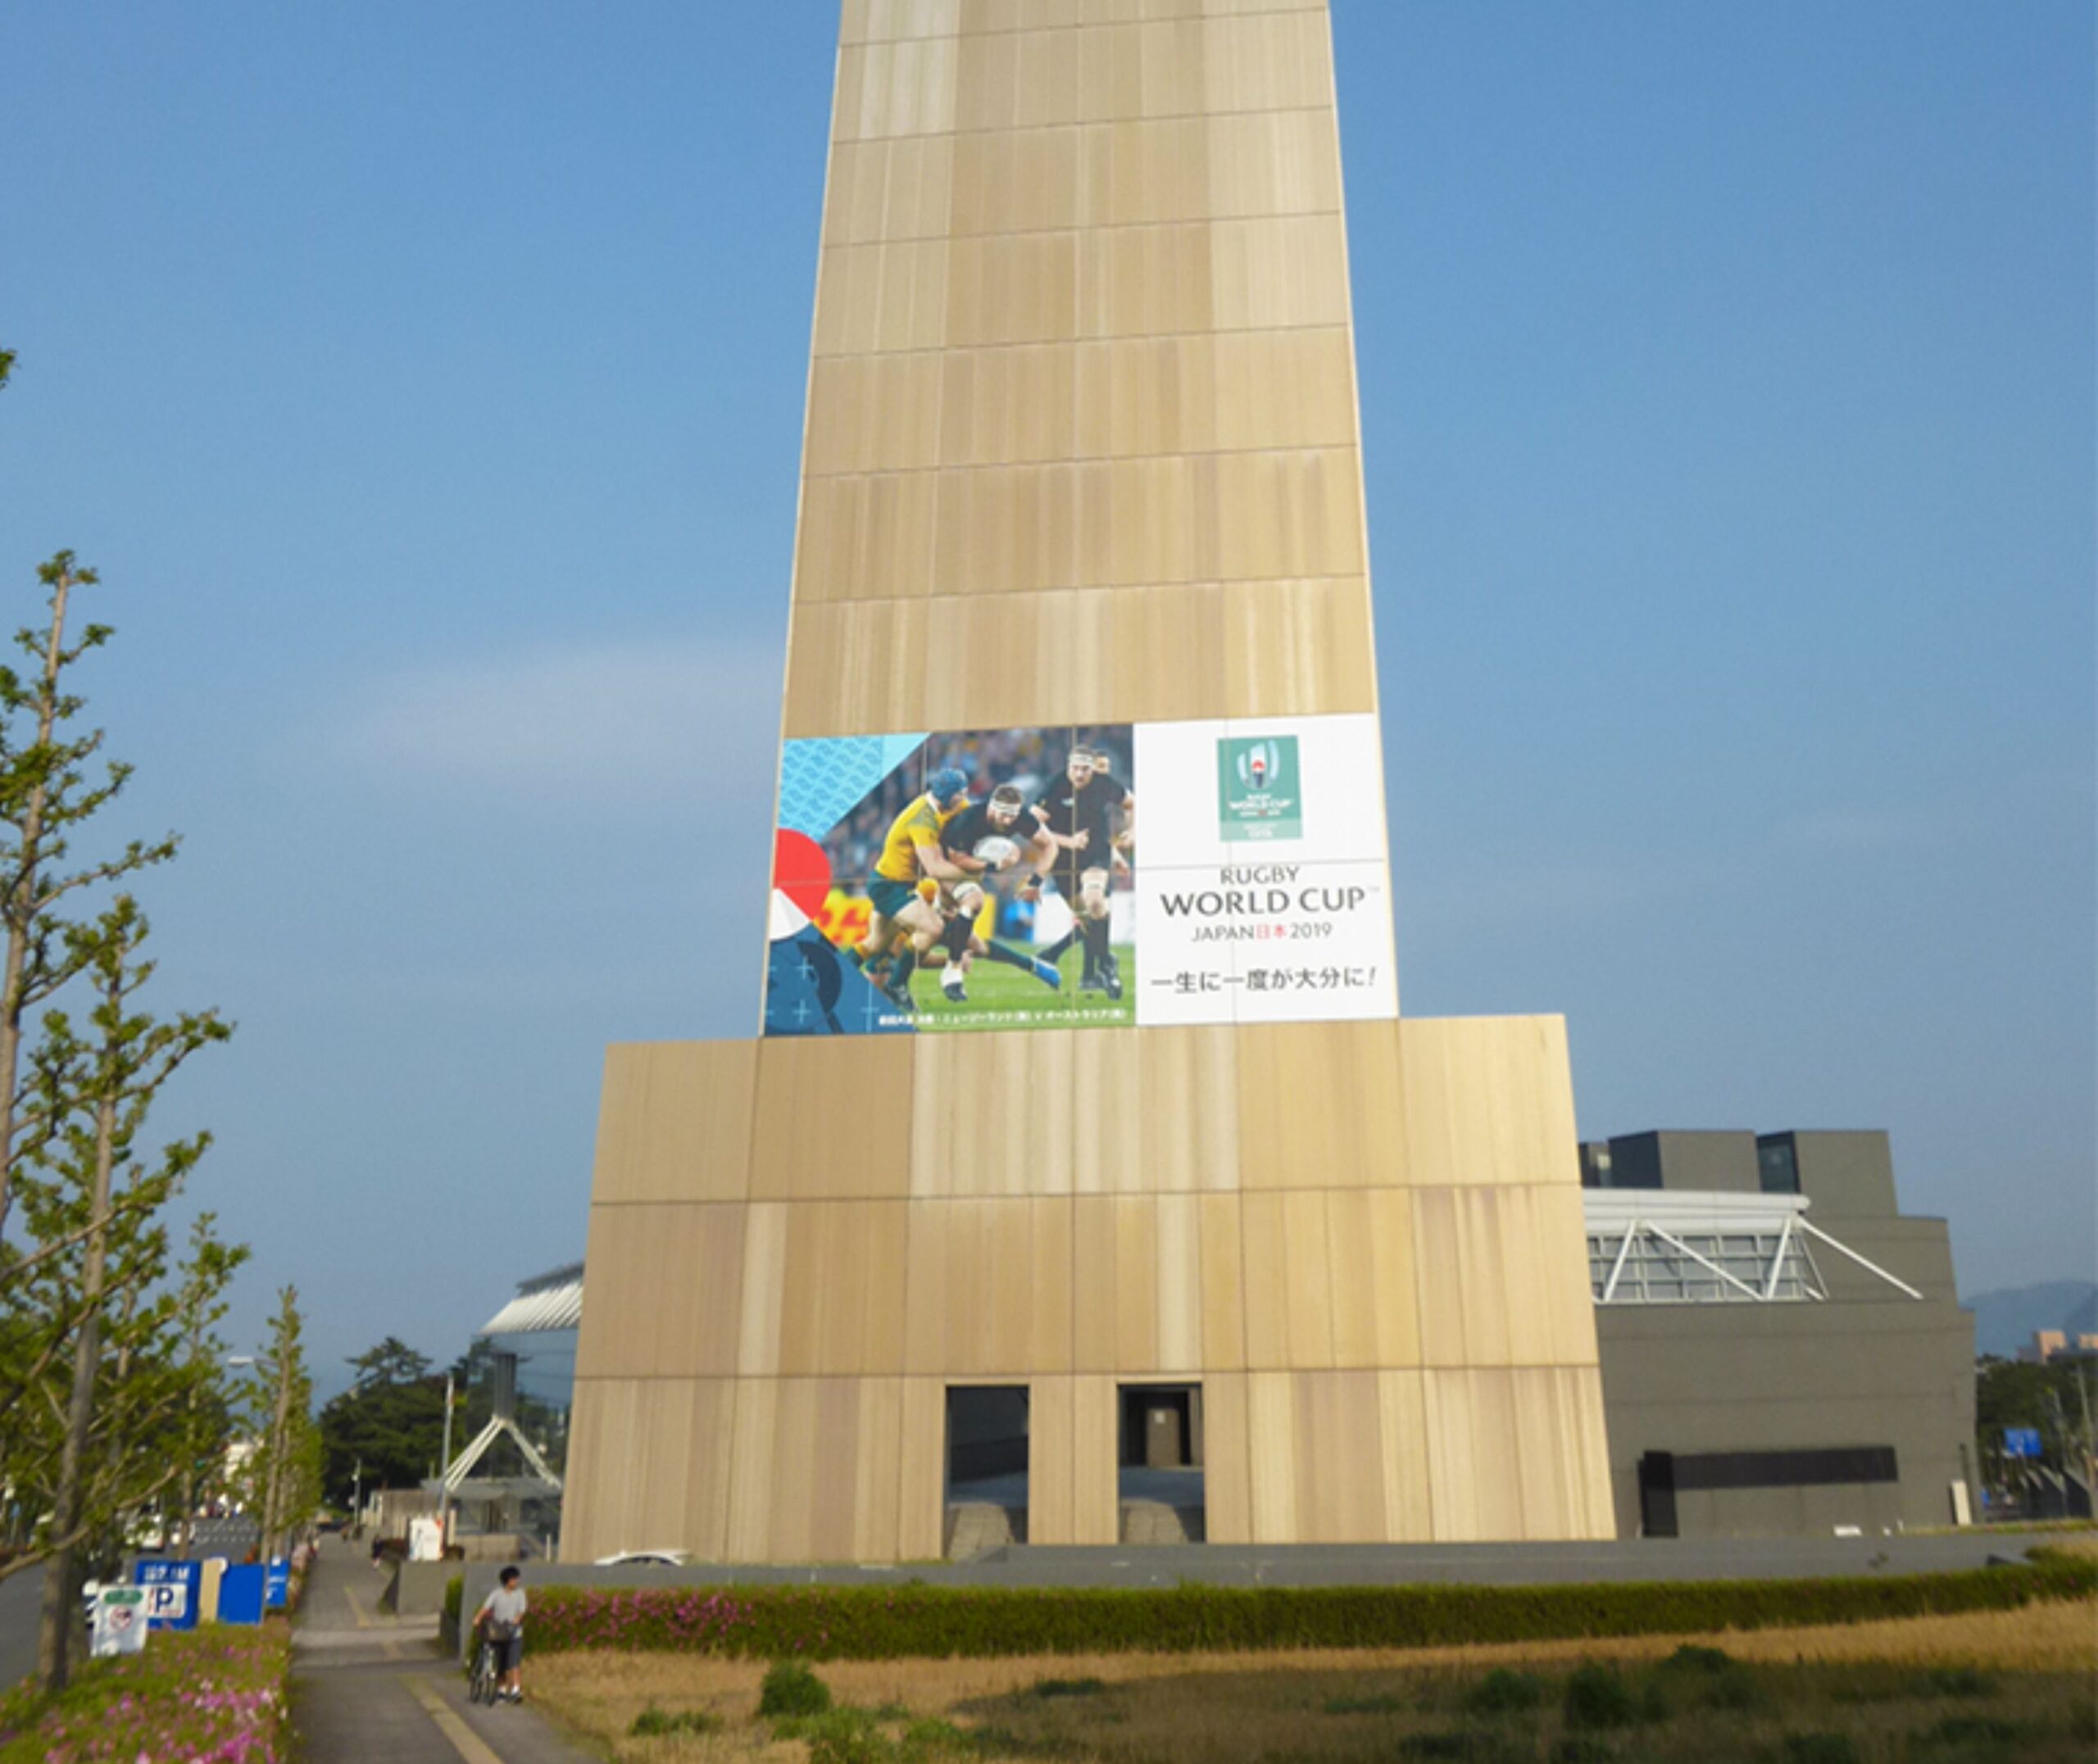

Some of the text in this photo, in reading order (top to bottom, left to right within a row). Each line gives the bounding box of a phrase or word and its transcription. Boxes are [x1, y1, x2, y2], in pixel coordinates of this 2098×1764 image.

[1219, 865, 1300, 885] RUGBY
[1160, 886, 1365, 917] WORLD CUP
